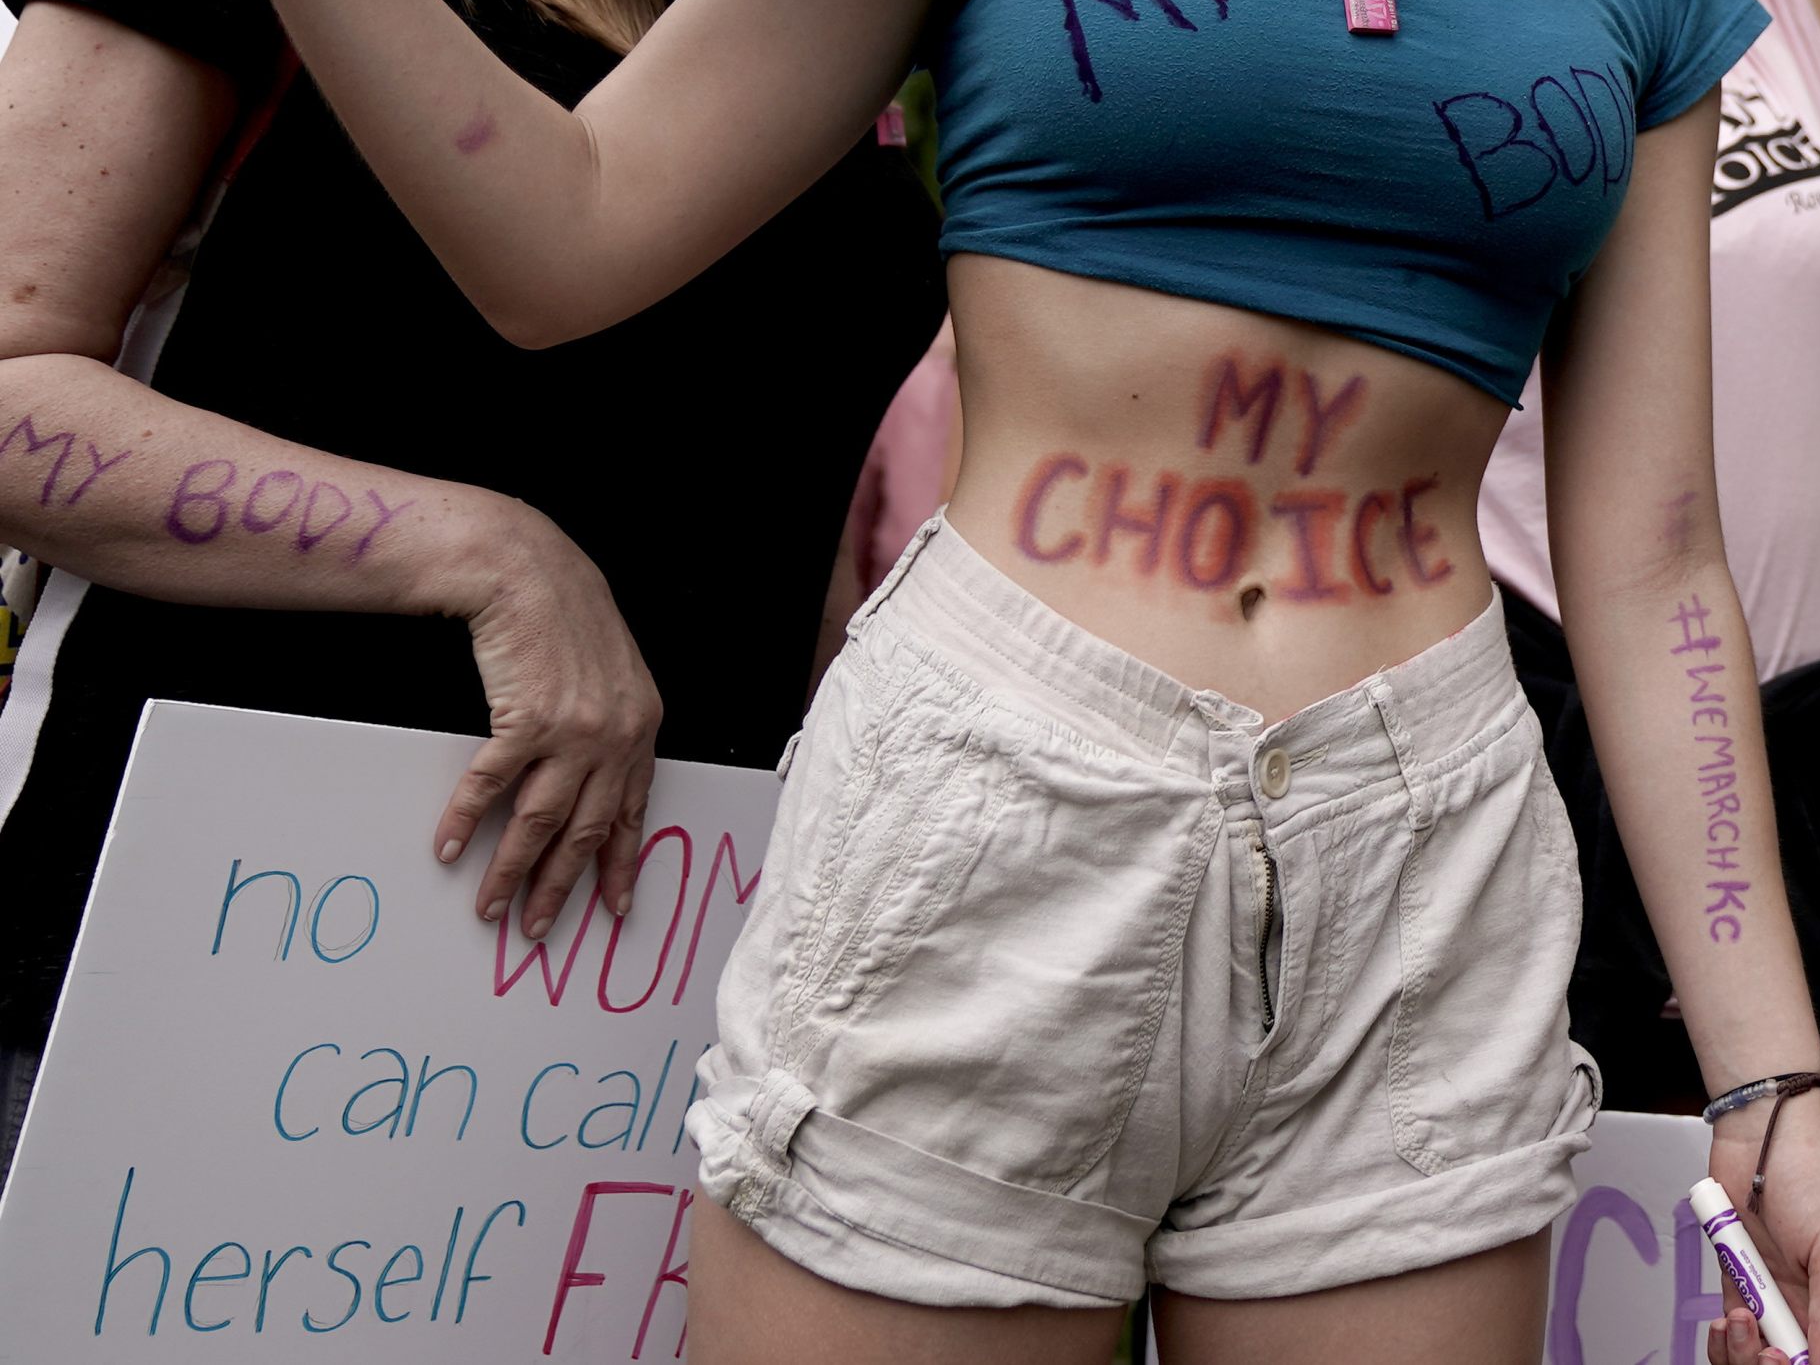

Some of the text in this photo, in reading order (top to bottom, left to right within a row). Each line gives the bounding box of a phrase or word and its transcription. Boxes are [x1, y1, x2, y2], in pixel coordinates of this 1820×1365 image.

[1200, 350, 1369, 478] MY
[164, 458, 420, 572] BODY
[1012, 449, 1457, 608] CHOICE
[211, 858, 381, 965] no
[273, 1039, 711, 1156] can call
[94, 1166, 527, 1337] herself
